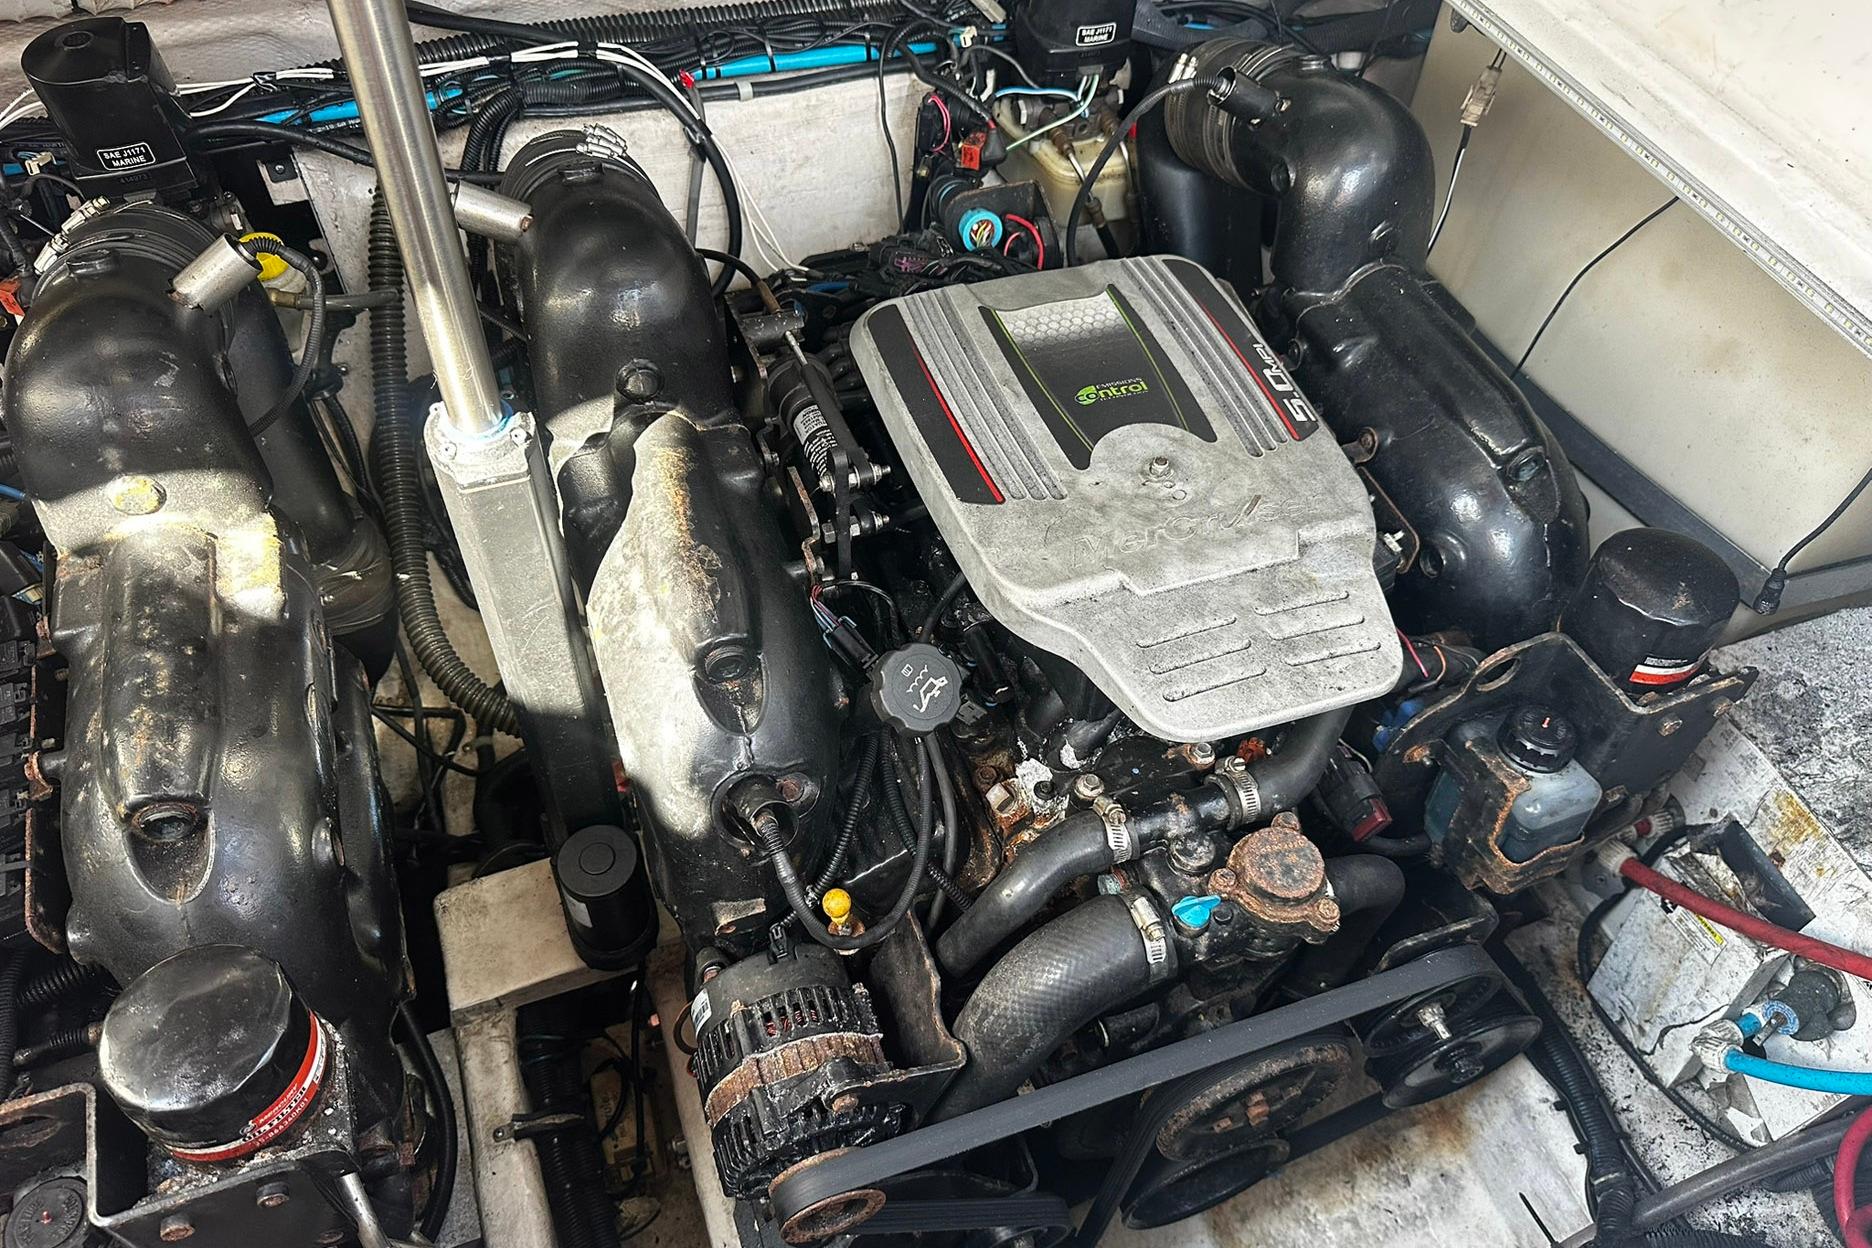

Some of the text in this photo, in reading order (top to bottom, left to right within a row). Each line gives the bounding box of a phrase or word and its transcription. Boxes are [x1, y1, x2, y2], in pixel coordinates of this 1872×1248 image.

[103, 146, 146, 160] SAE J1171
[111, 154, 147, 167] MARINE
[242, 1086, 307, 1142] OIL FILTER
